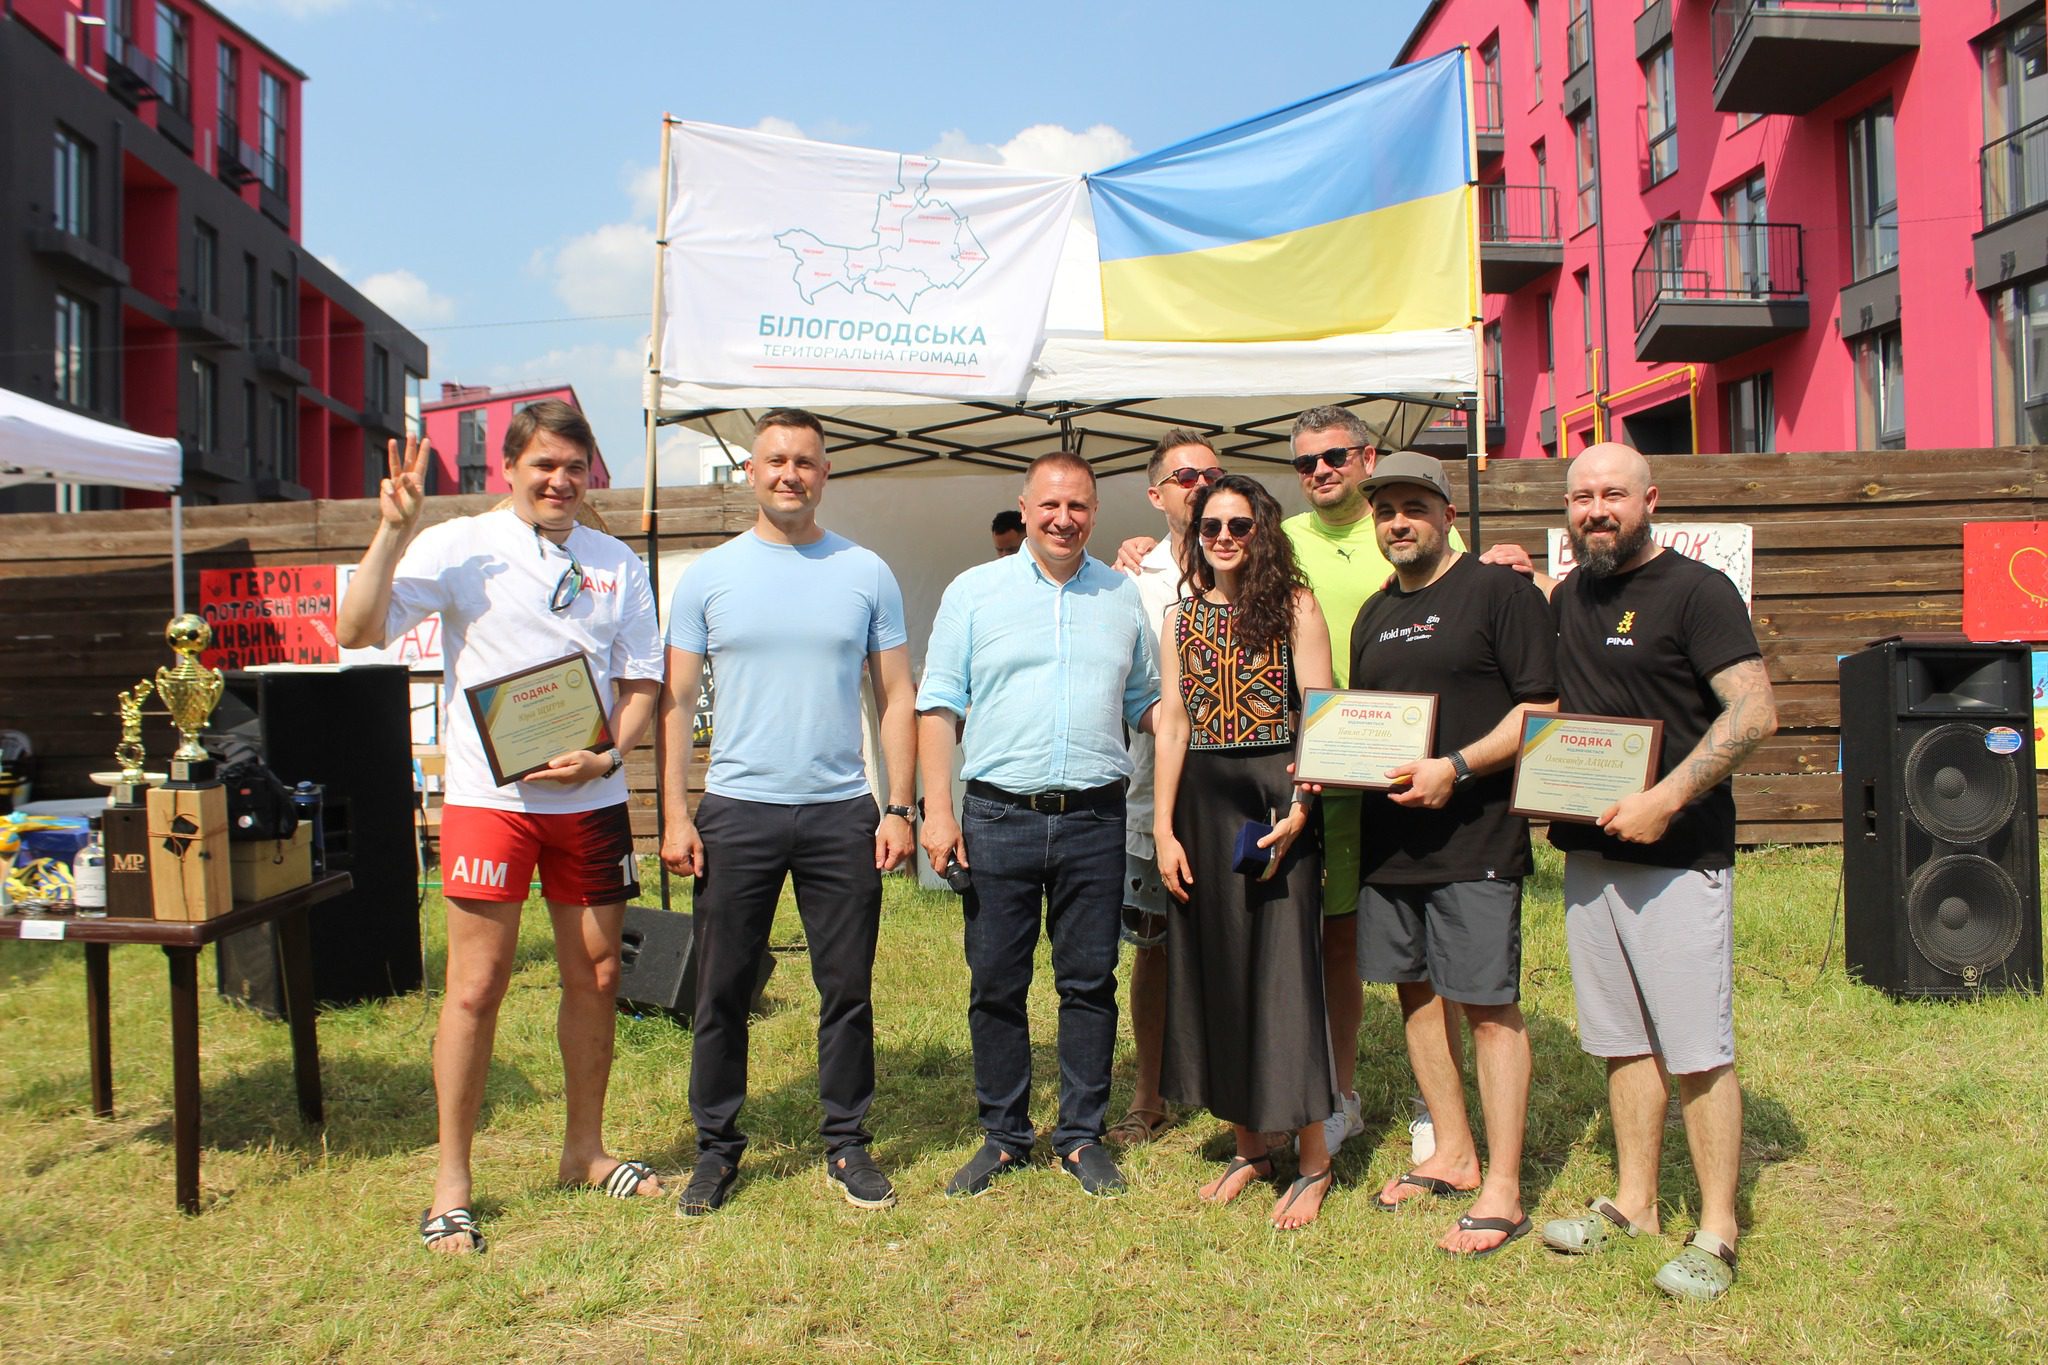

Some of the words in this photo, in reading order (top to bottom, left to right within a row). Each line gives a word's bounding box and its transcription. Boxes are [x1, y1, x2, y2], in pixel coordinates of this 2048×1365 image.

[759, 314, 987, 347] БІЛОГОРОДСЬКА
[763, 344, 895, 361] ТЕРИТОРІАЛЬНА
[900, 350, 978, 367] ГРОМАДА
[229, 567, 302, 597] ГЕРОЇ
[580, 576, 617, 595] AIM
[297, 596, 331, 616] НАМ
[1426, 614, 1440, 624] gin
[1379, 627, 1399, 642] Hold
[1399, 626, 1413, 638] my
[1606, 637, 1634, 646] PINA
[512, 682, 559, 704] ПОДЯКА
[1341, 709, 1392, 720] ПОДЯКА
[1560, 735, 1612, 748] ПОДЯКА
[451, 855, 508, 888] AIM
